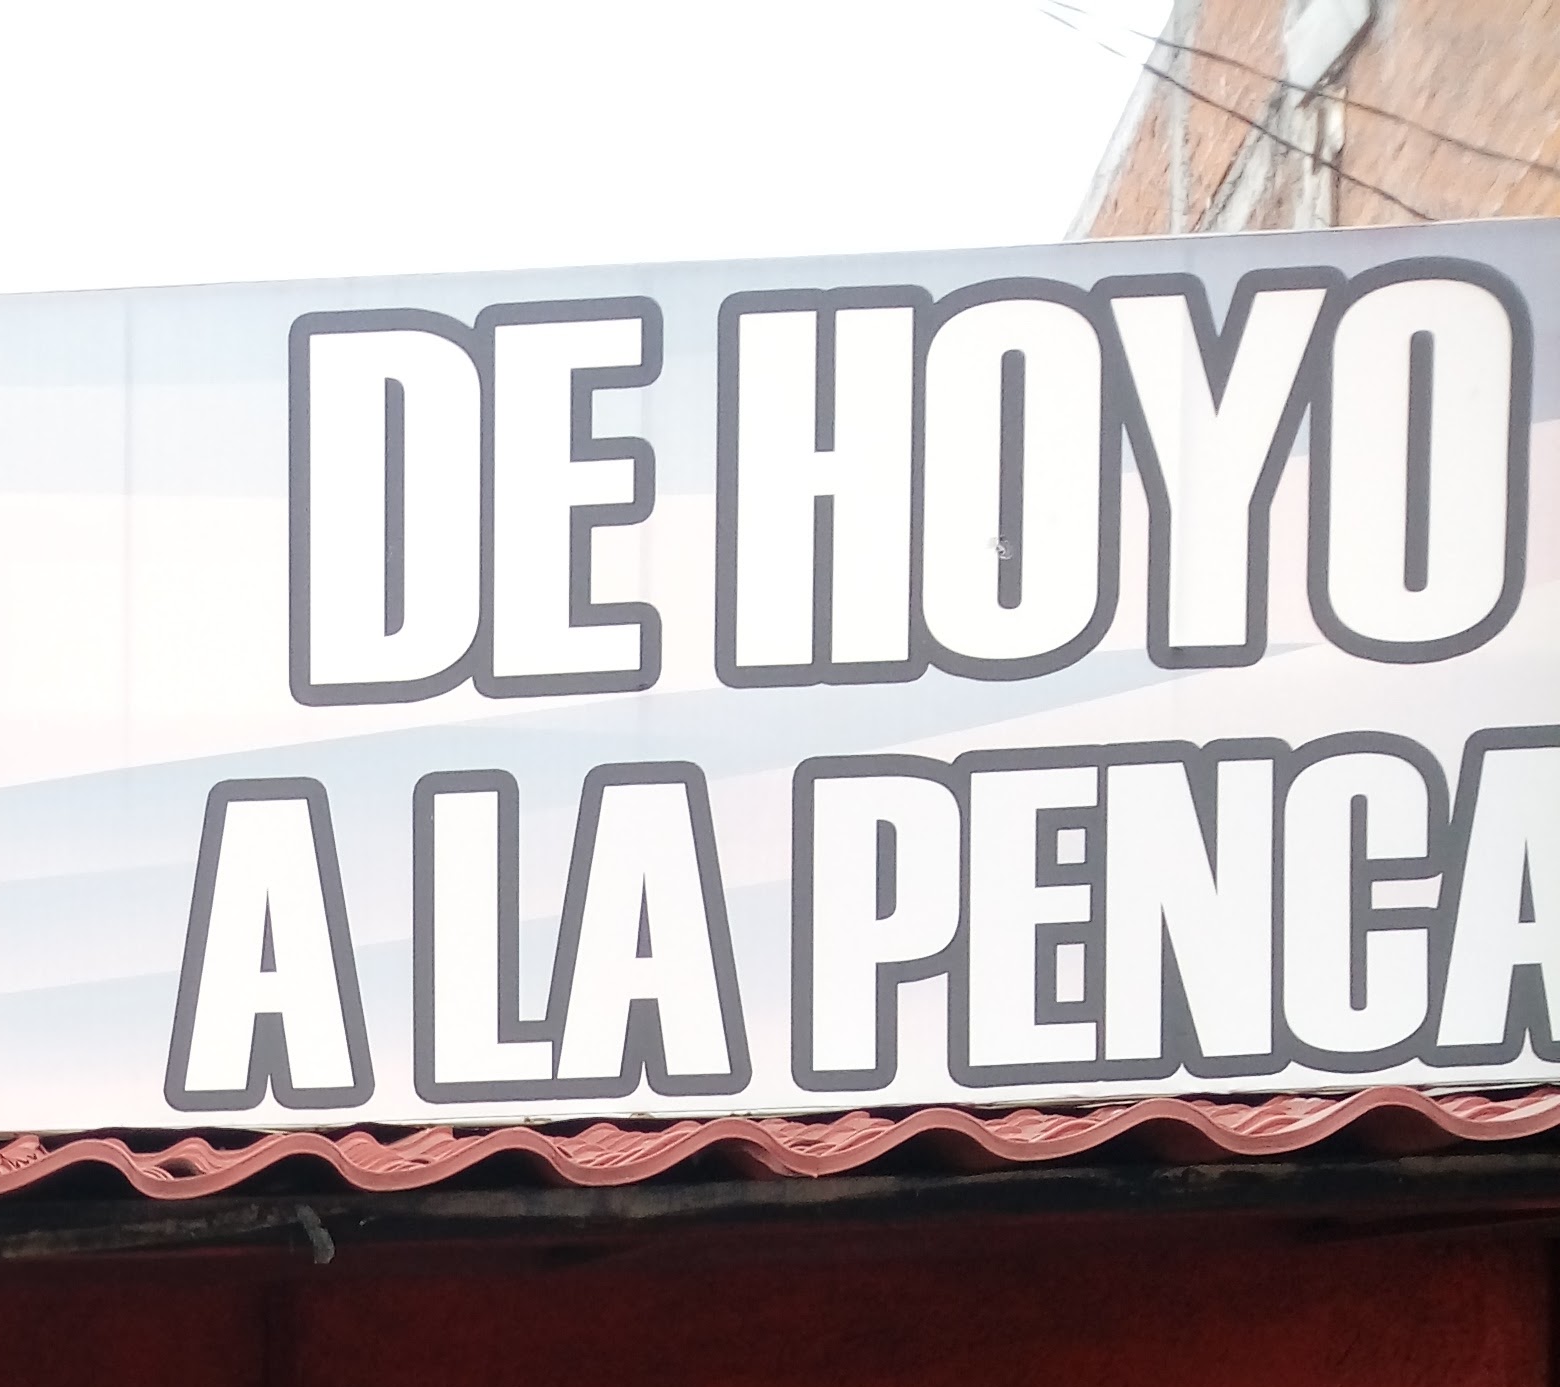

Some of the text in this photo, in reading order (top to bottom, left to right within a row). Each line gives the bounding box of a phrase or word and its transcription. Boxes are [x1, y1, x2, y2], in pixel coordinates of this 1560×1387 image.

[288, 256, 1534, 707] DE HOYO
[164, 722, 1560, 1112] A LA PENCA
